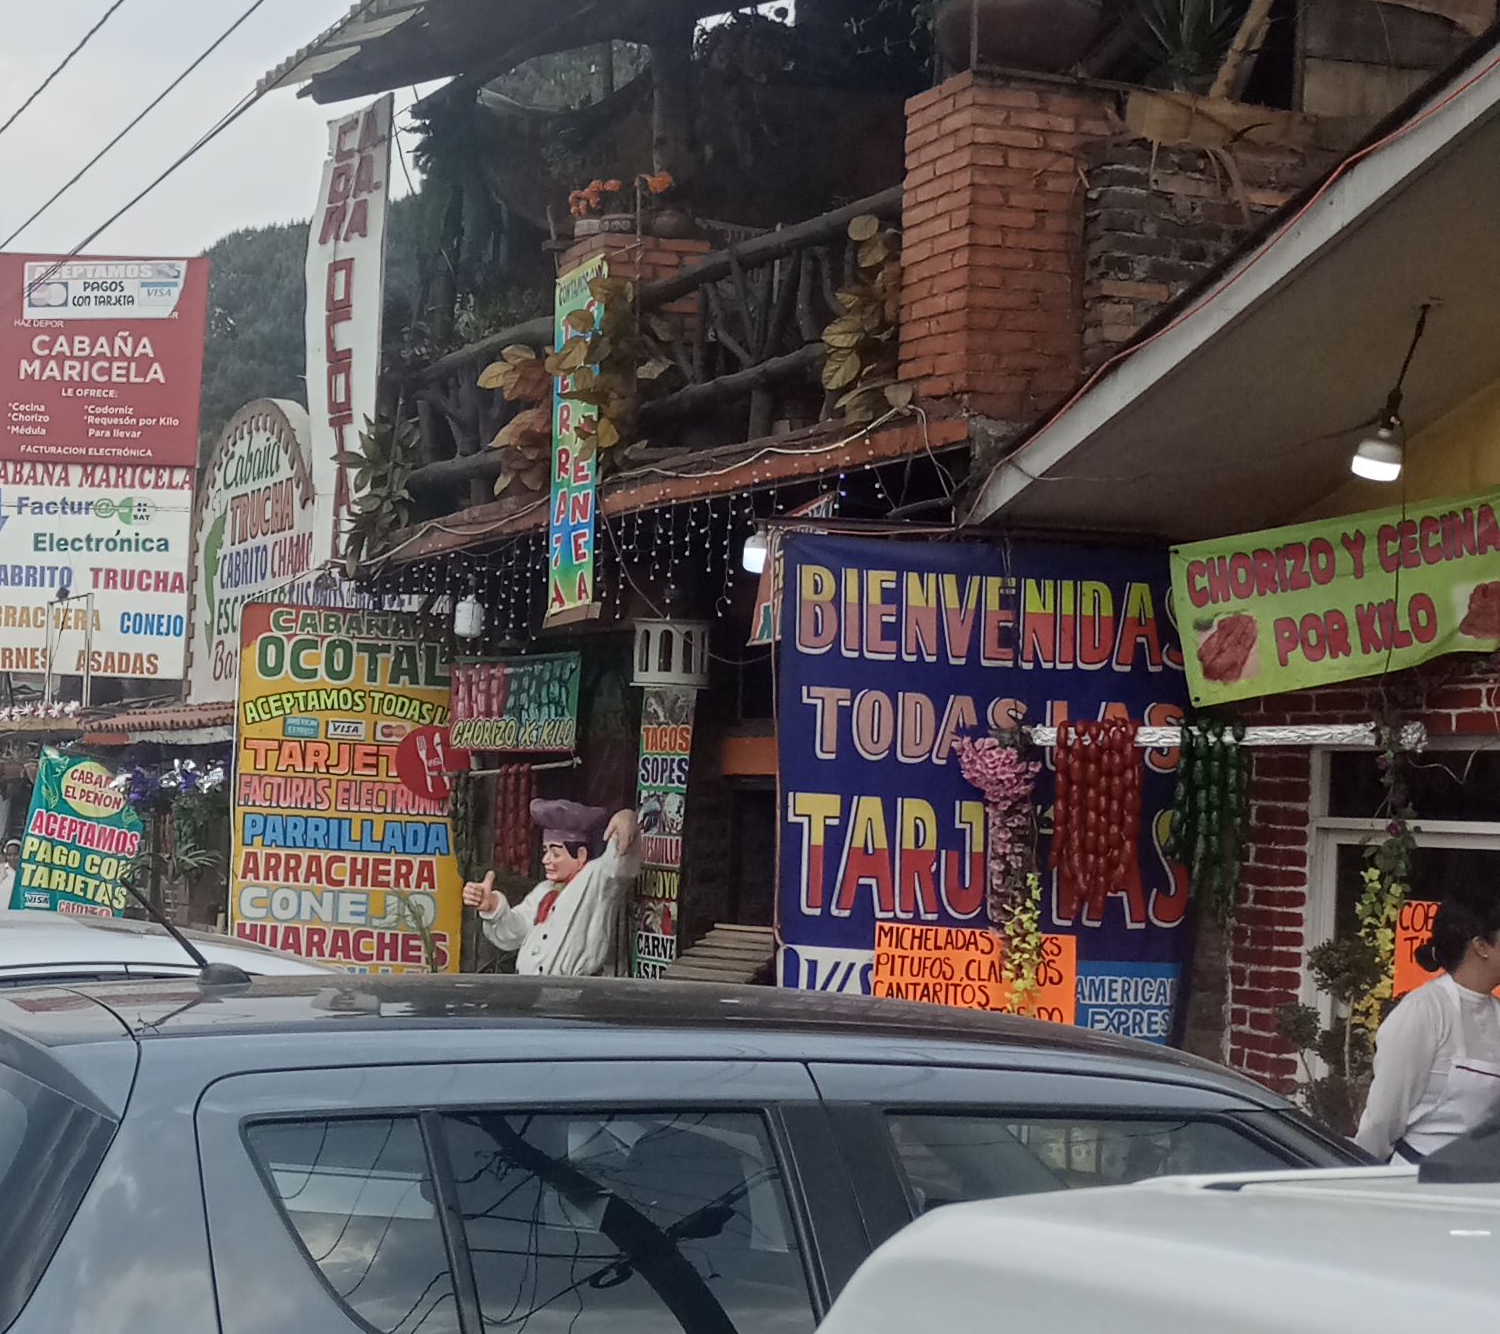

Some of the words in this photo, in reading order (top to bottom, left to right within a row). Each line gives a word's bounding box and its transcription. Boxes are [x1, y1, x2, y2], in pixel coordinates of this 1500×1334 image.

[34, 265, 152, 279] ACEPTAMOS
[83, 281, 124, 292] PAGOS
[146, 288, 172, 298] VISA
[72, 296, 91, 306] CON
[94, 295, 134, 306] TARJETA
[31, 331, 154, 358] CABAÑA
[19, 359, 166, 384] MARICELA
[61, 388, 74, 397] LE
[75, 389, 118, 398] OFRECE:
[88, 429, 111, 438] Para
[112, 429, 141, 439] llevar
[139, 418, 157, 428] por
[159, 417, 179, 426] Kilo
[20, 444, 86, 455] FACTURACION
[78, 465, 194, 490] MARICELA
[230, 477, 294, 546] TRUCHA
[33, 530, 169, 552] Electrónica
[220, 544, 268, 589] CABRITO
[1187, 537, 1336, 608] CHORIZO
[1341, 528, 1366, 579] Y
[1377, 503, 1500, 573] CECINA
[90, 568, 185, 594] TRUCHA
[120, 612, 184, 637] CONEJO
[1273, 609, 1352, 667] POR
[1355, 592, 1438, 655] KILO
[75, 650, 159, 675] ASADAS
[257, 633, 451, 688] OCOTAL
[244, 688, 366, 724] ACEPTAMOS
[368, 690, 433, 724] TODAS
[332, 724, 359, 733] VISA
[451, 718, 516, 747] CHORIZO
[520, 718, 537, 747] X
[539, 718, 574, 748] KILO
[641, 725, 691, 753] TACOS
[639, 756, 689, 786] SOPES
[64, 785, 77, 800] EL
[238, 774, 331, 810] FACTURAS
[29, 809, 140, 857] ACEPTAMOS
[242, 813, 449, 854] PARRILLADA
[22, 837, 81, 868] PAGO
[85, 854, 130, 883] CON
[239, 850, 437, 891] ARRACHERA
[21, 864, 128, 909] TARJETAS
[27, 894, 49, 906] VISA
[239, 886, 436, 930] CONEJO
[877, 925, 994, 955] MICHELADAS
[874, 953, 954, 980] PITUFOS
[873, 982, 990, 1006] CANTARITOS
